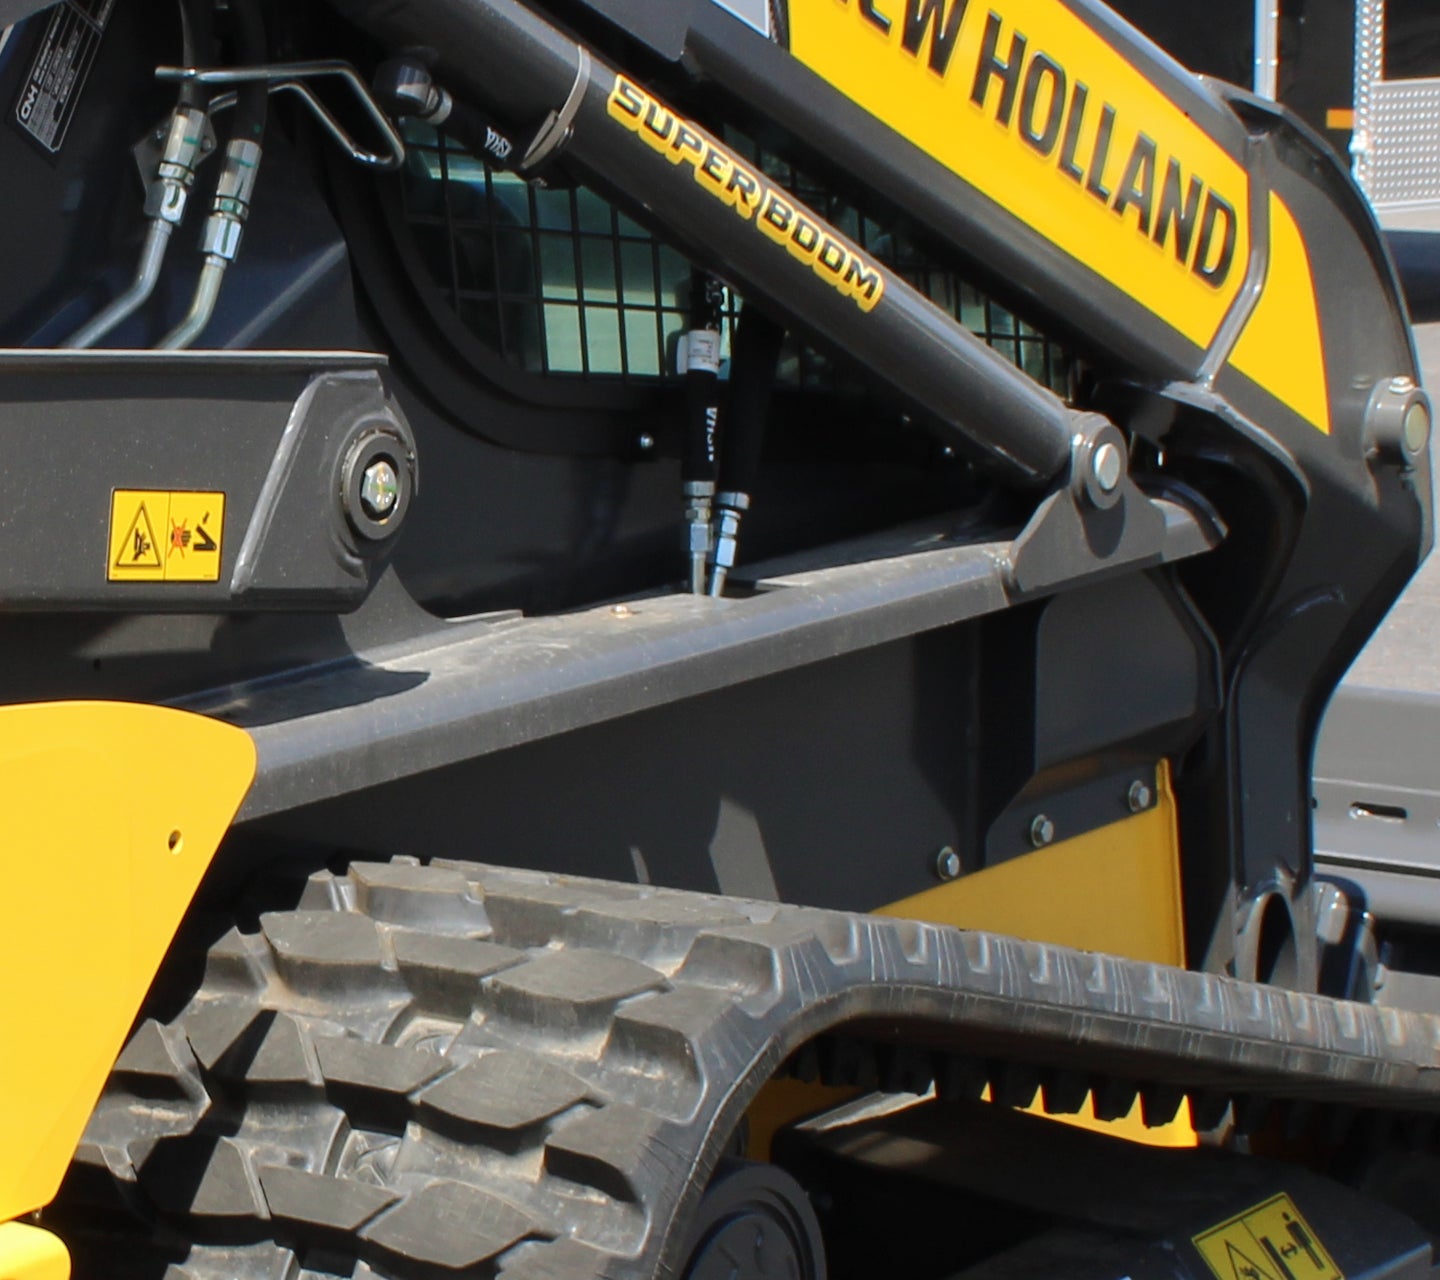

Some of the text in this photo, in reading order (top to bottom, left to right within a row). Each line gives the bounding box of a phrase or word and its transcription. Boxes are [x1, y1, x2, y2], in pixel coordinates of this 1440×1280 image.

[608, 73, 763, 218] SUPER
[756, 186, 886, 311] BOOM
[969, 8, 1239, 289] HOLLAND
